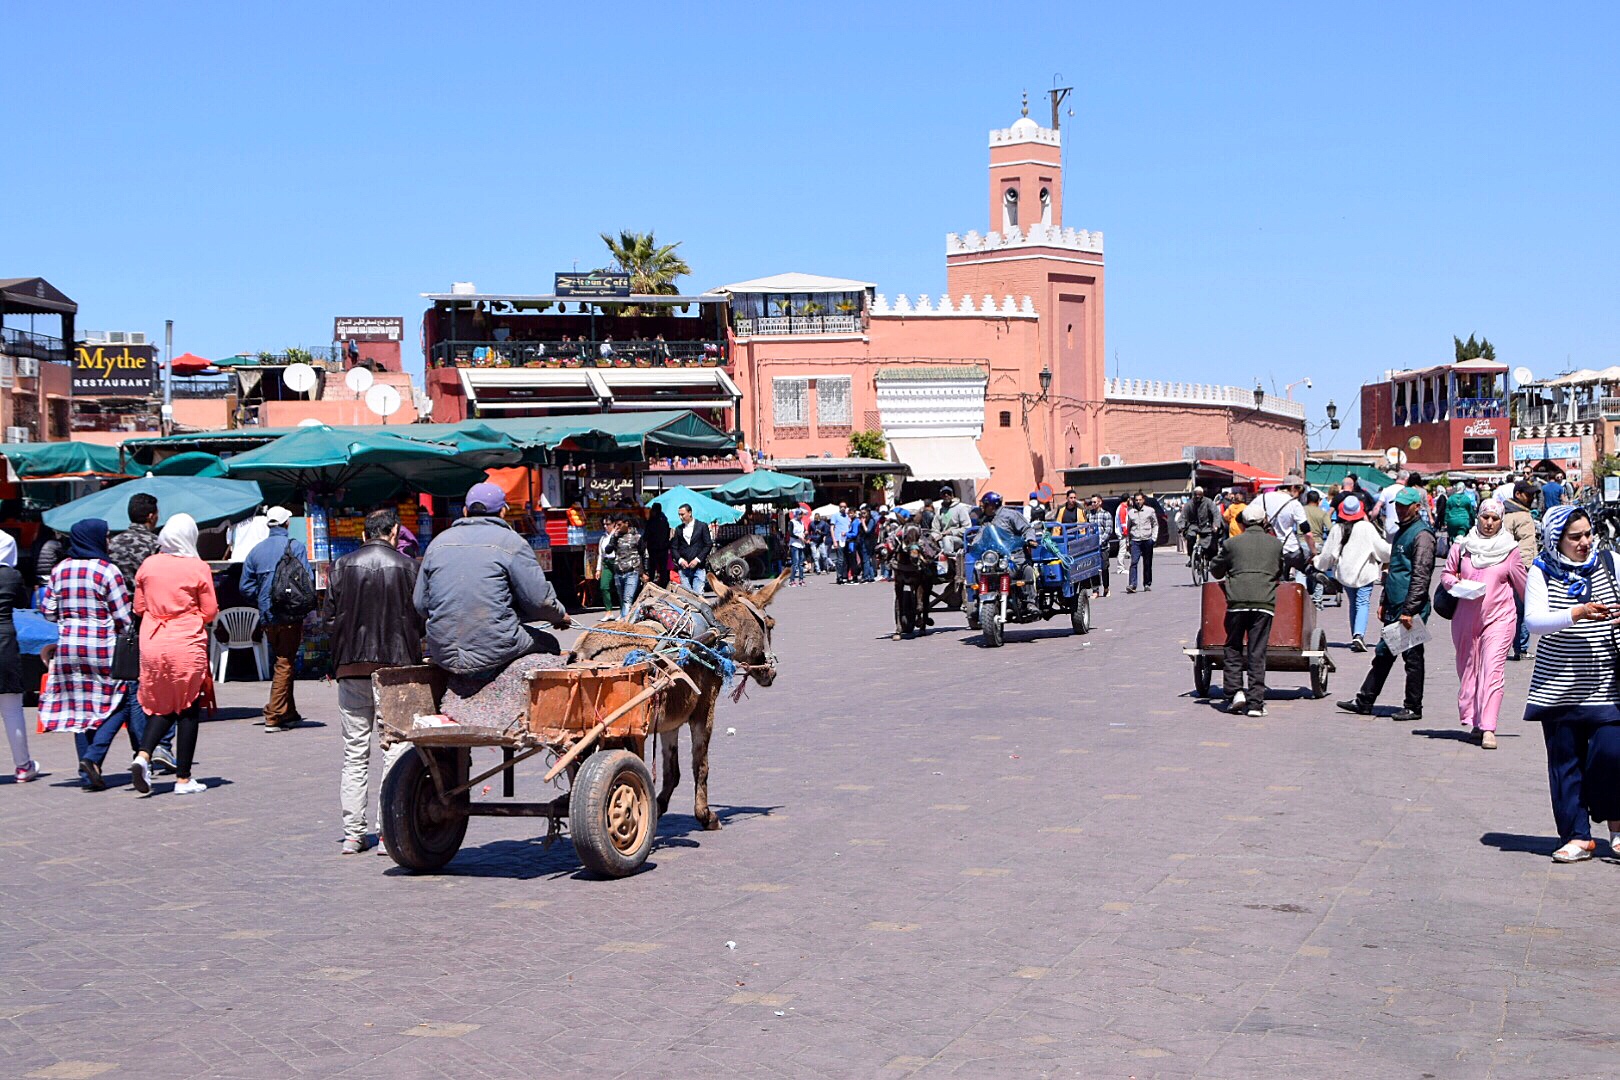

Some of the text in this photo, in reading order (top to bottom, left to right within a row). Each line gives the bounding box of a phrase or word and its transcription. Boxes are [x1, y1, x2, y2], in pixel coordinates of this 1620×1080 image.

[603, 277, 629, 288] Café
[74, 347, 147, 379] Mythe
[73, 379, 151, 387] RESTAURANT
